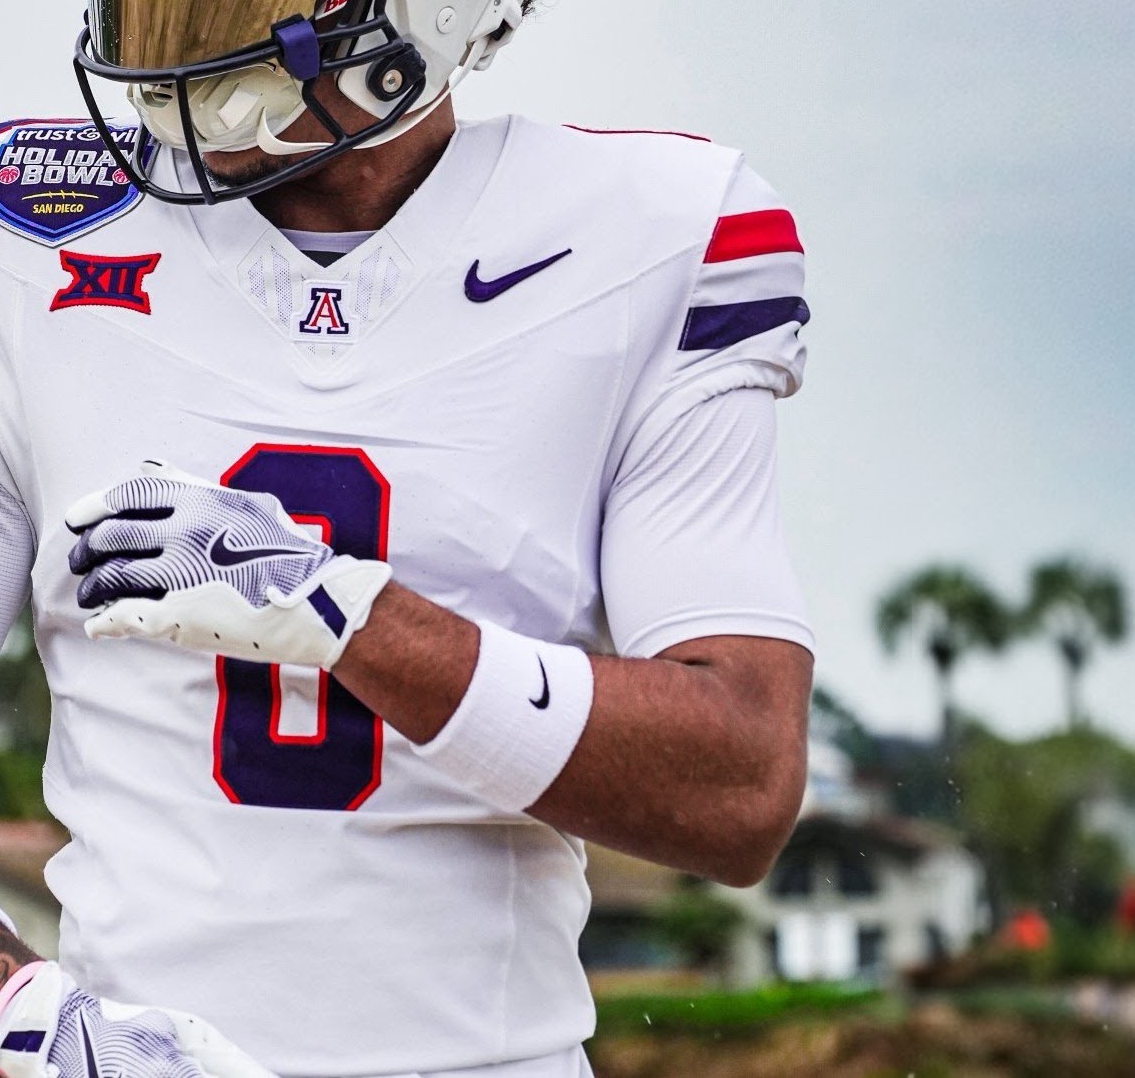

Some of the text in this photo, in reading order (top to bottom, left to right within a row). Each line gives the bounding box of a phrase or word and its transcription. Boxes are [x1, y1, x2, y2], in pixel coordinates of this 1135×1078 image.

[20, 165, 114, 186] BOWL
[32, 203, 84, 214] SAN DIEGO
[58, 257, 153, 306] XII
[299, 287, 349, 335] A
